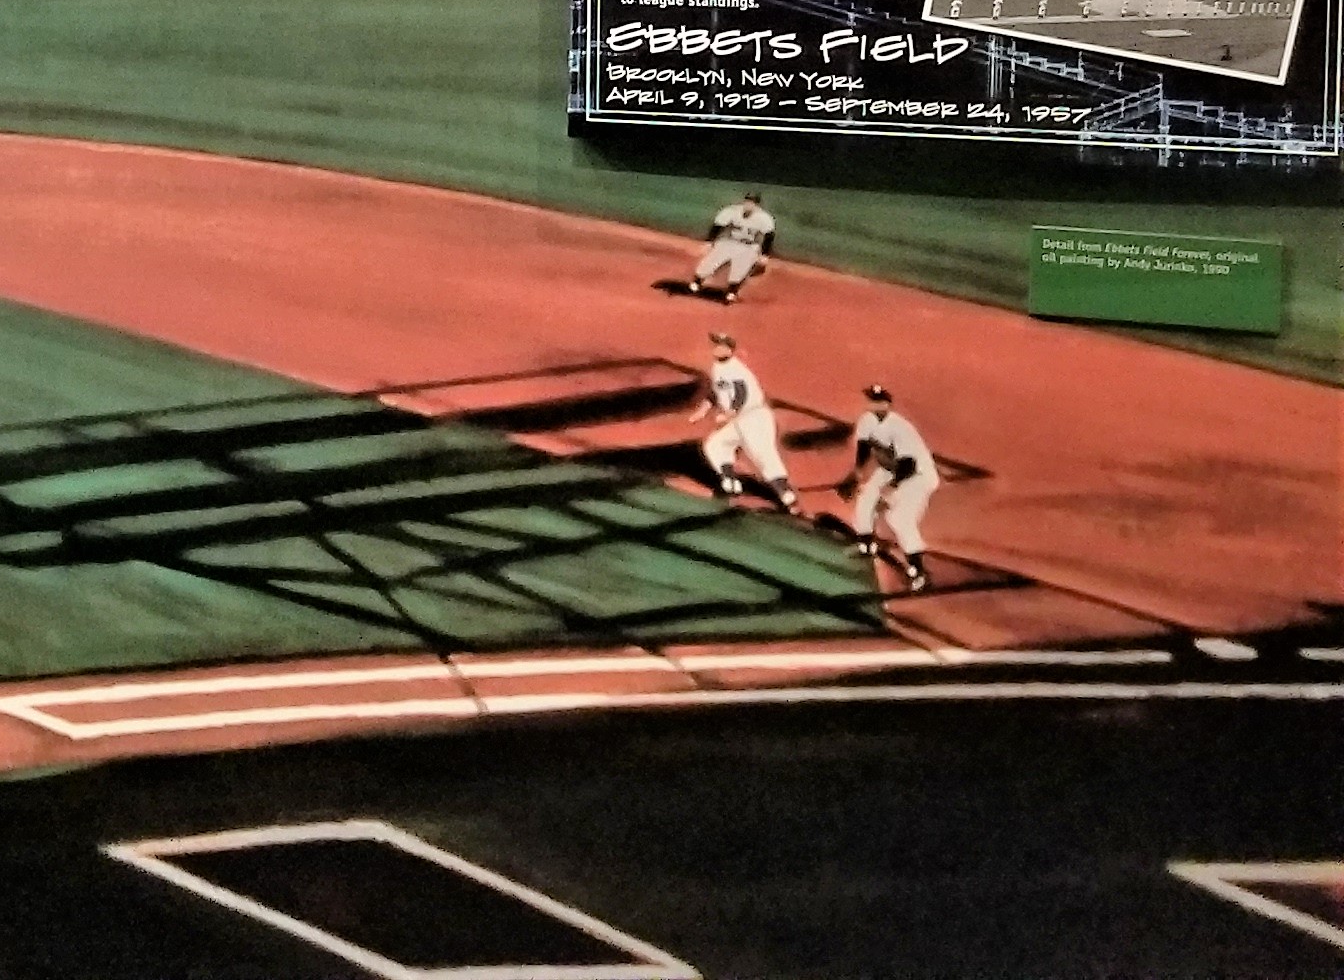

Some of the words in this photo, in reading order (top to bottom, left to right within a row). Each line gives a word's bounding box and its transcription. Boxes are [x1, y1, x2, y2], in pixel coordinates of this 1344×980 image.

[607, 22, 801, 62] EBBETS
[819, 28, 968, 64] FIELD
[606, 63, 732, 86] BROOKLYN,
[799, 71, 864, 91] YORK
[606, 87, 674, 104] APRIL
[680, 91, 704, 109] 9,
[714, 92, 770, 109] 1913
[804, 95, 959, 118] SEPTEMBER
[966, 102, 1010, 124] 24,
[1022, 106, 1092, 126] 1957
[1107, 256, 1121, 269] by
